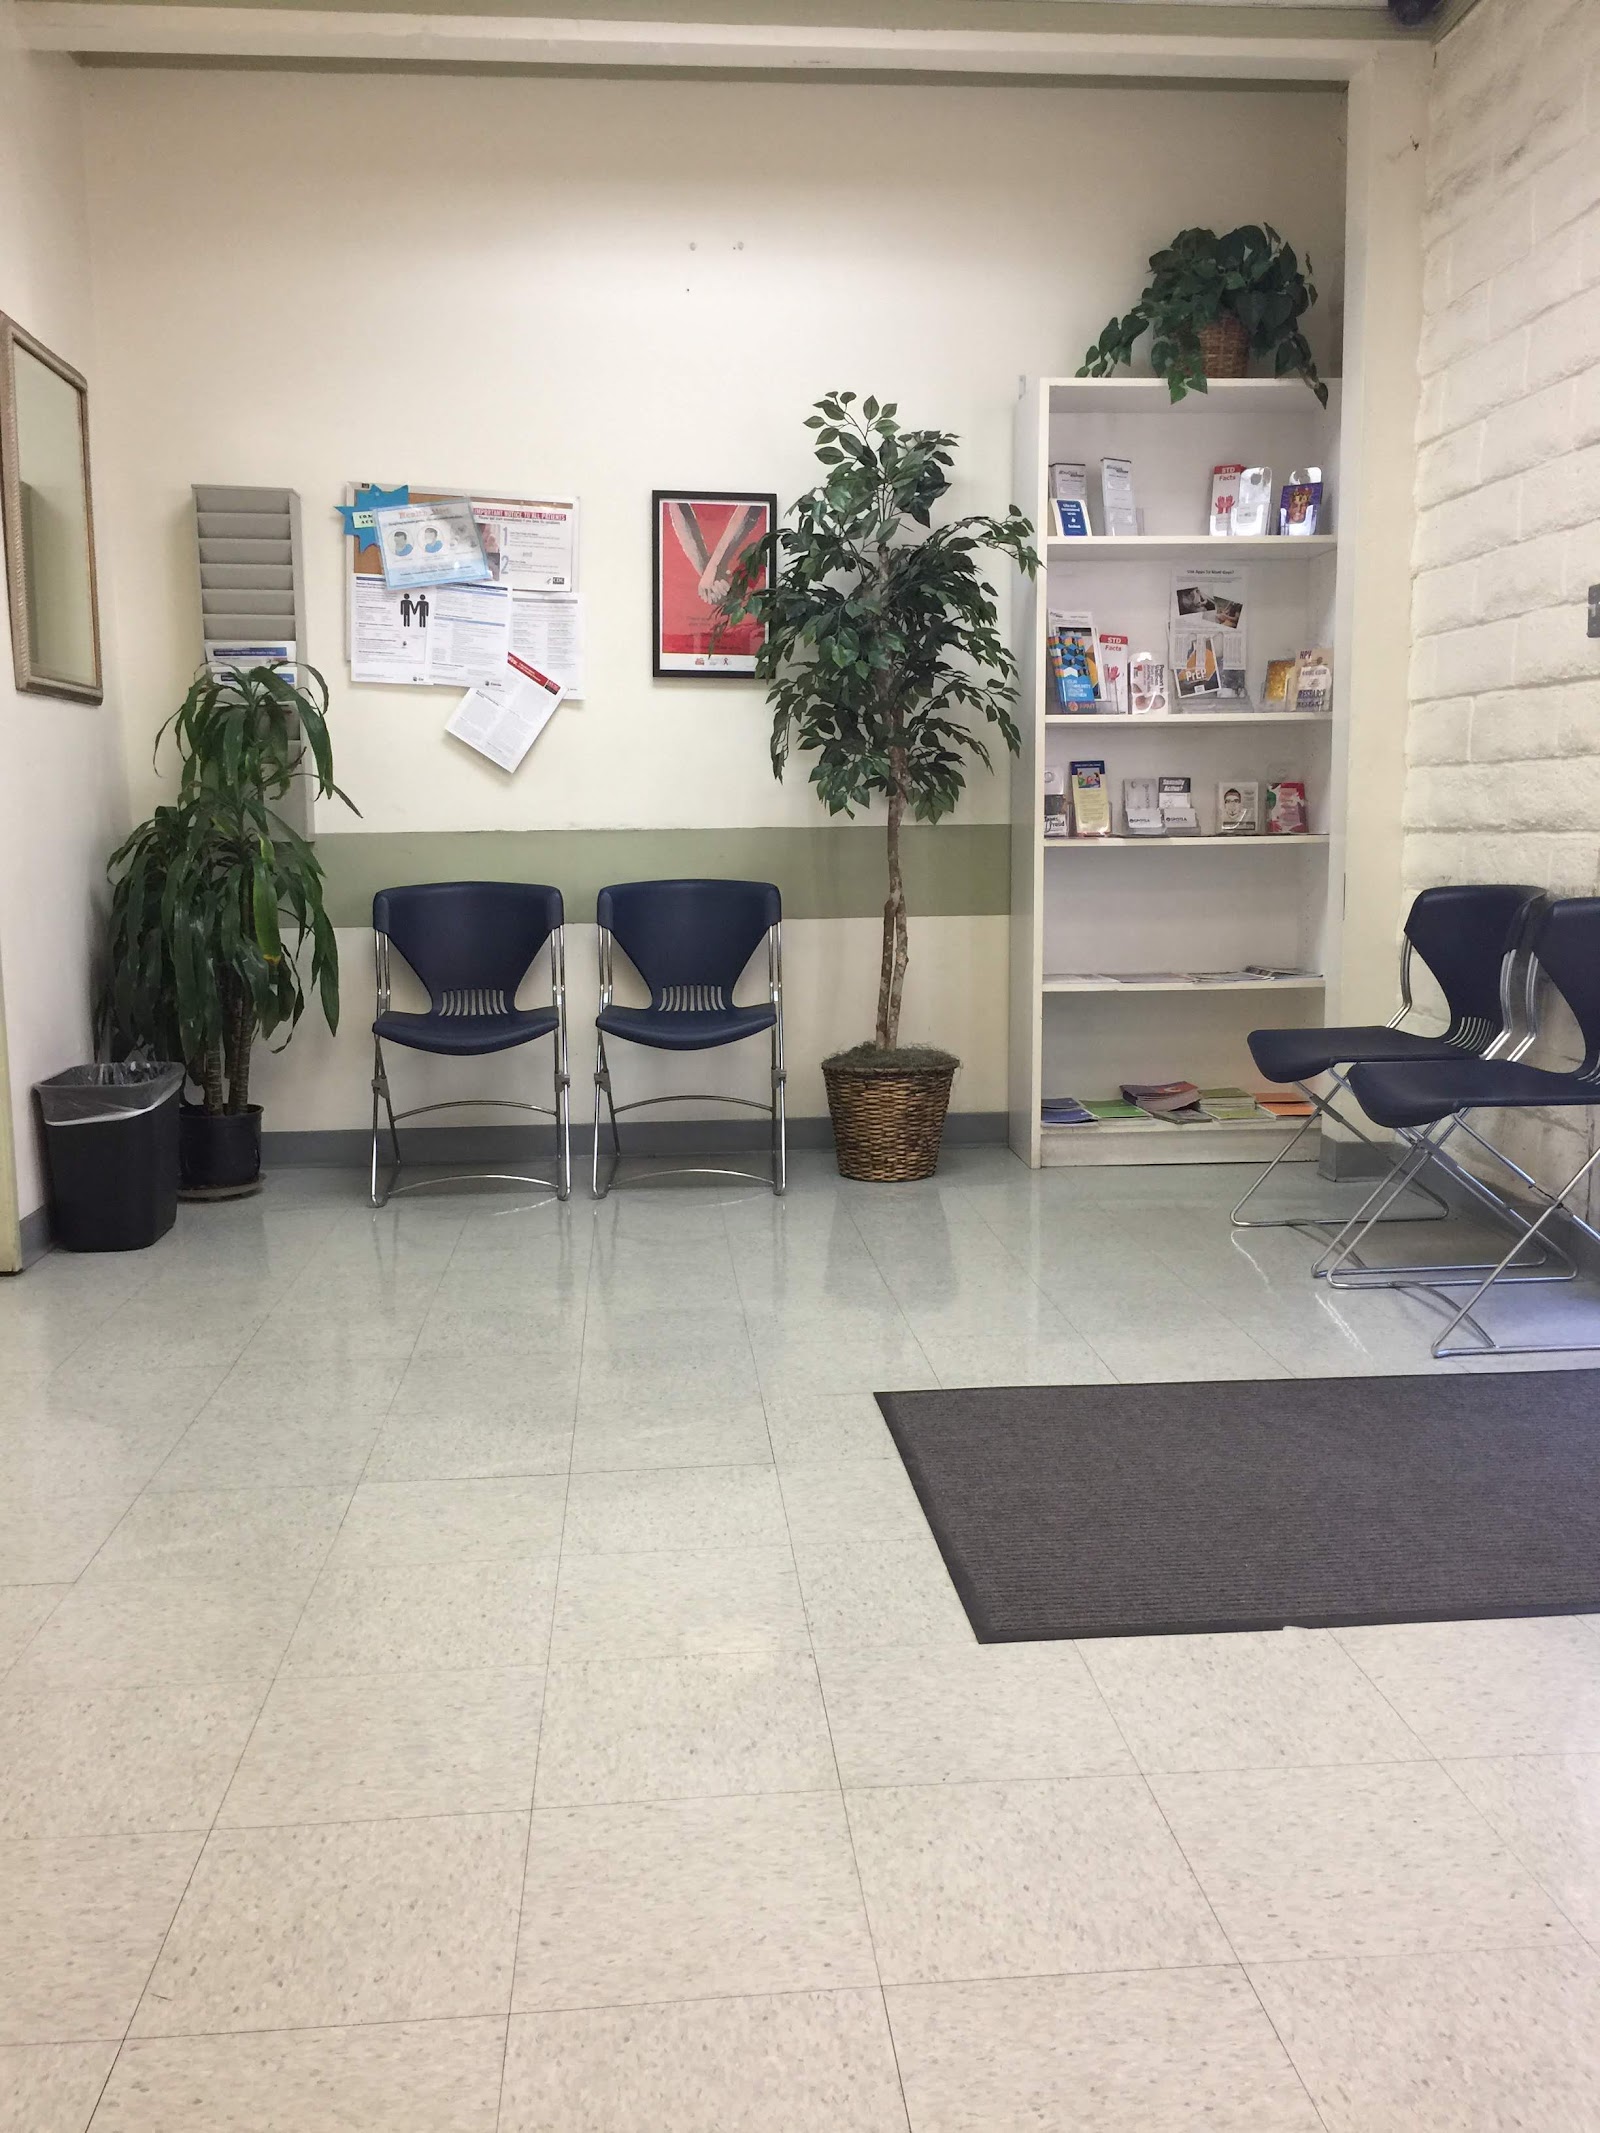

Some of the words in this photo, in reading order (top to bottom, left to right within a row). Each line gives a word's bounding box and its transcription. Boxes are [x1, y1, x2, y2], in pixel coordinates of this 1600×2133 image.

[503, 526, 508, 546] 1
[501, 555, 509, 575] 2
[1186, 669, 1206, 681] PrEP
